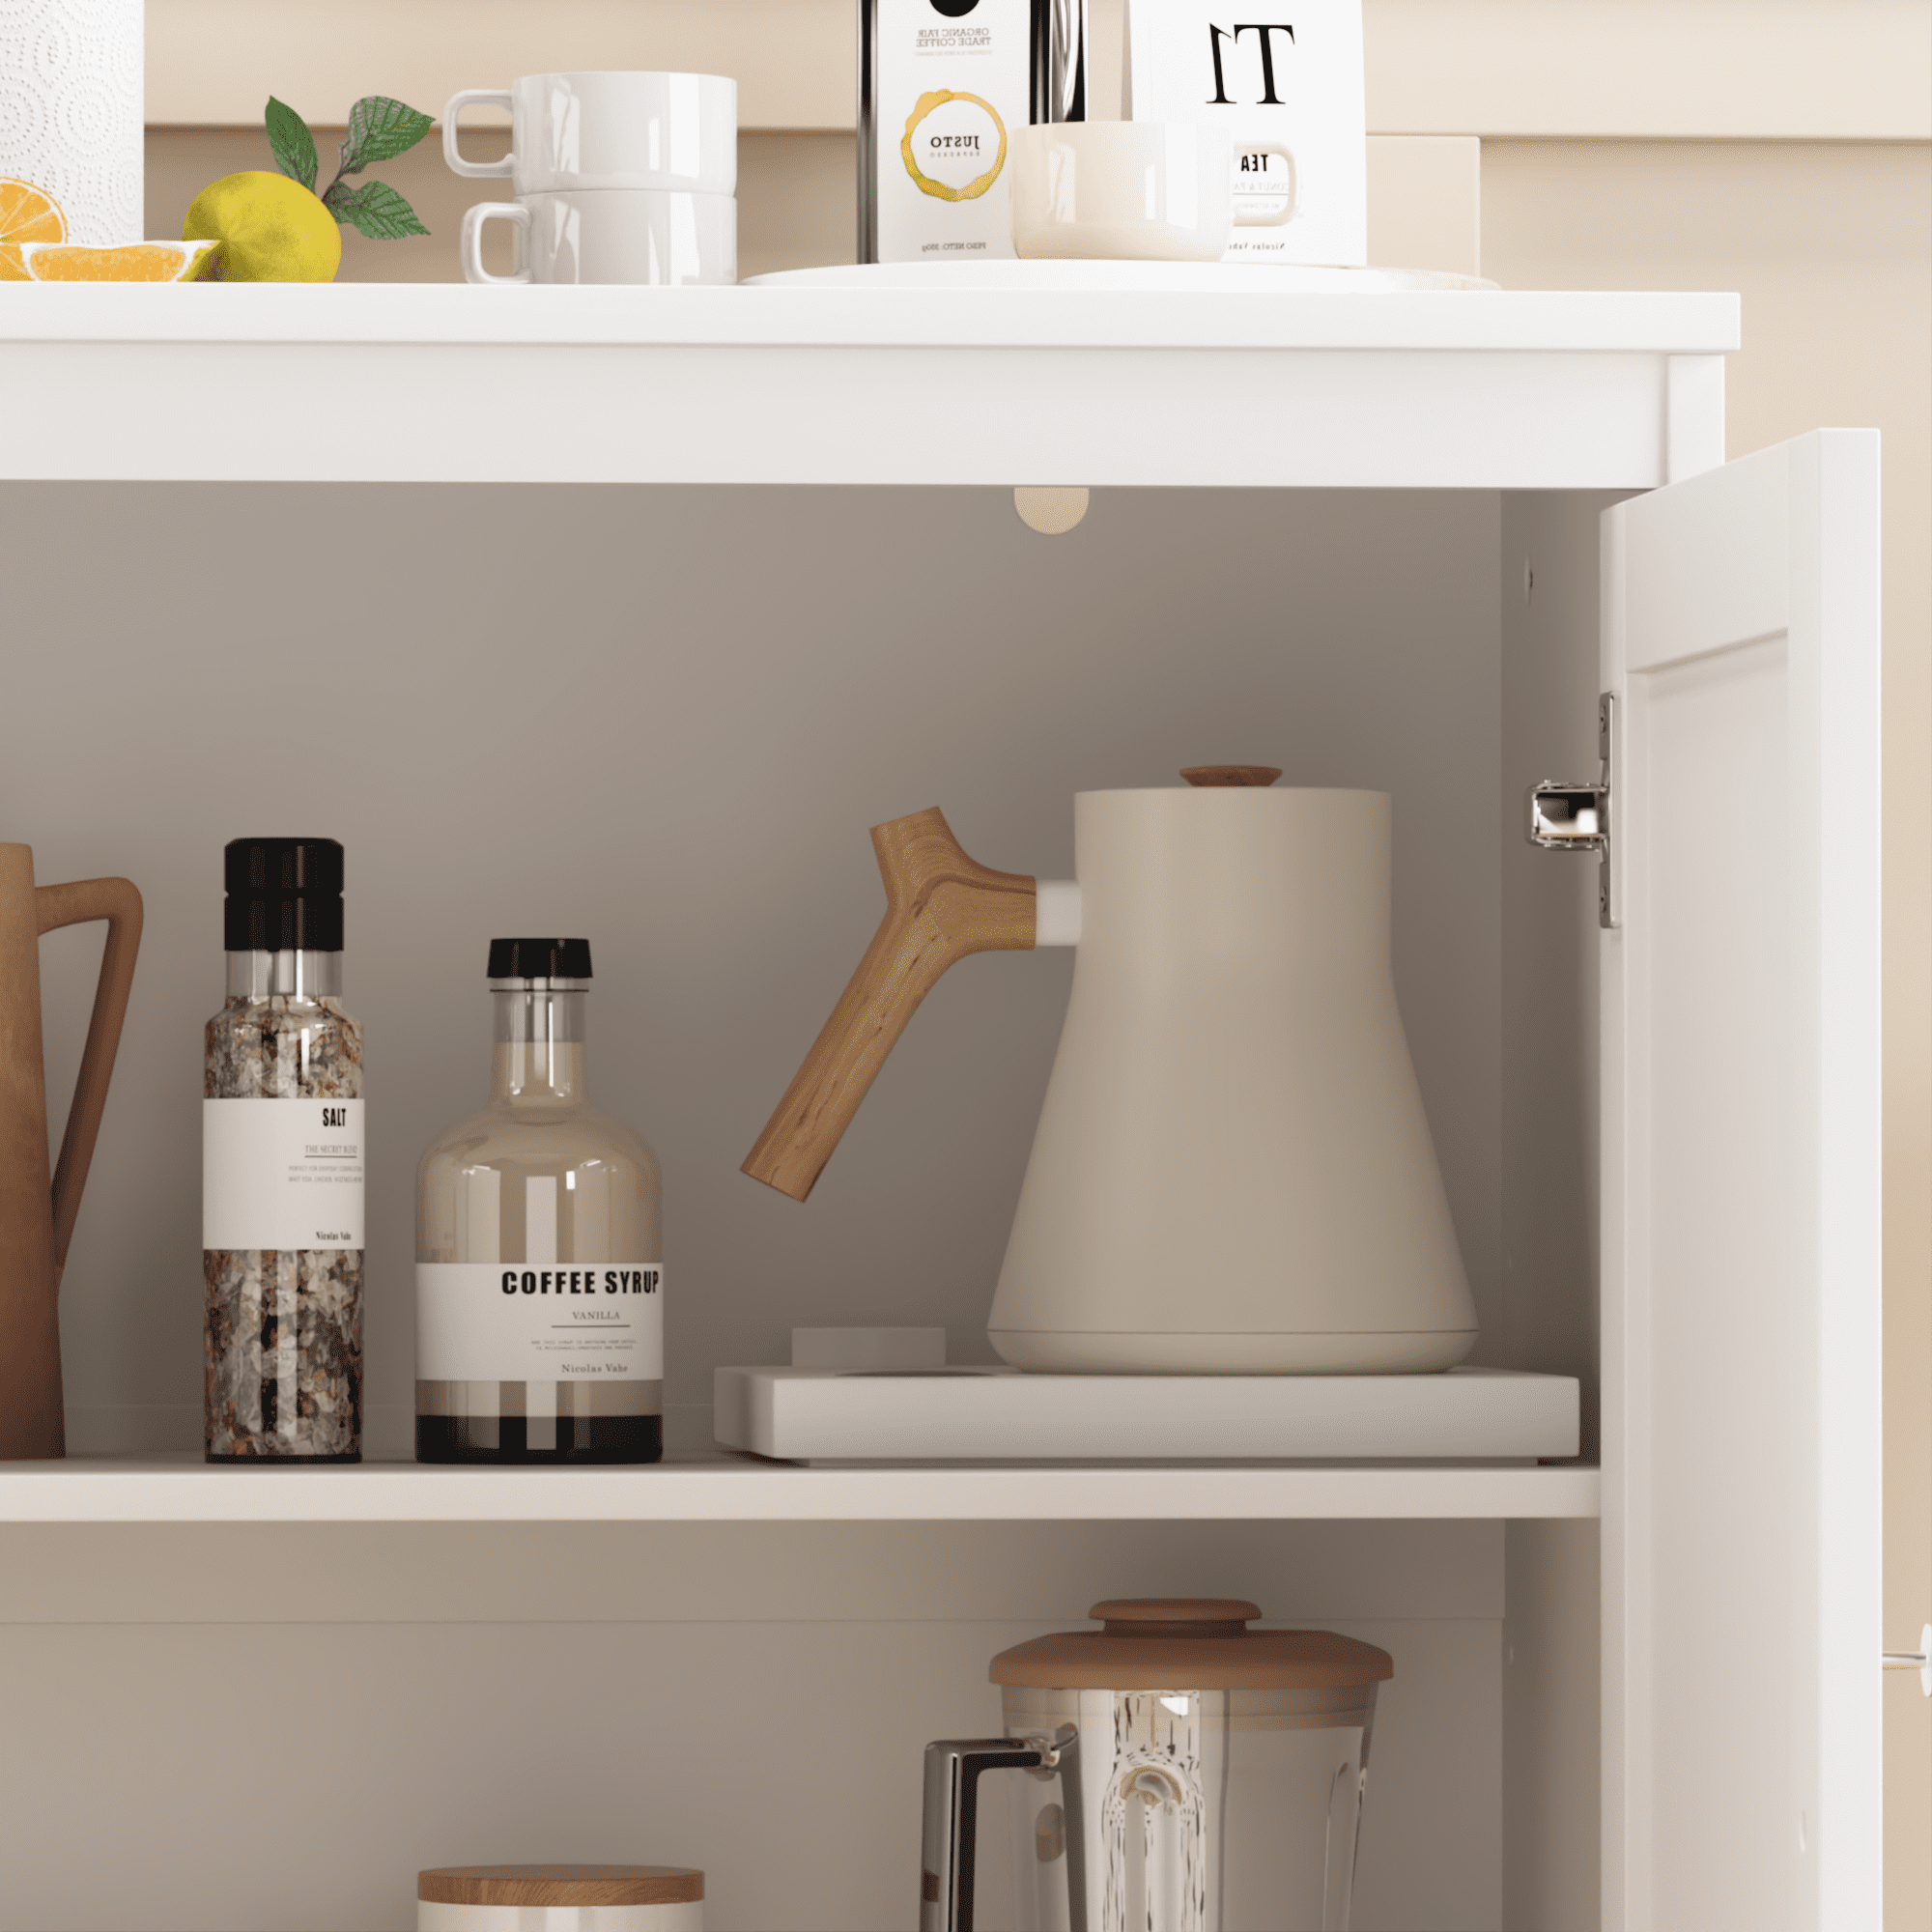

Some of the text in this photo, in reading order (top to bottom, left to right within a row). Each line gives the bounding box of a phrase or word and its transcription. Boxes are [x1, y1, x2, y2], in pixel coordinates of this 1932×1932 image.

[323, 1108, 347, 1127] SALT
[501, 1270, 659, 1294] COFFEE SYRUP
[572, 1311, 620, 1320] VANILLA
[561, 1364, 602, 1373] Nicolas
